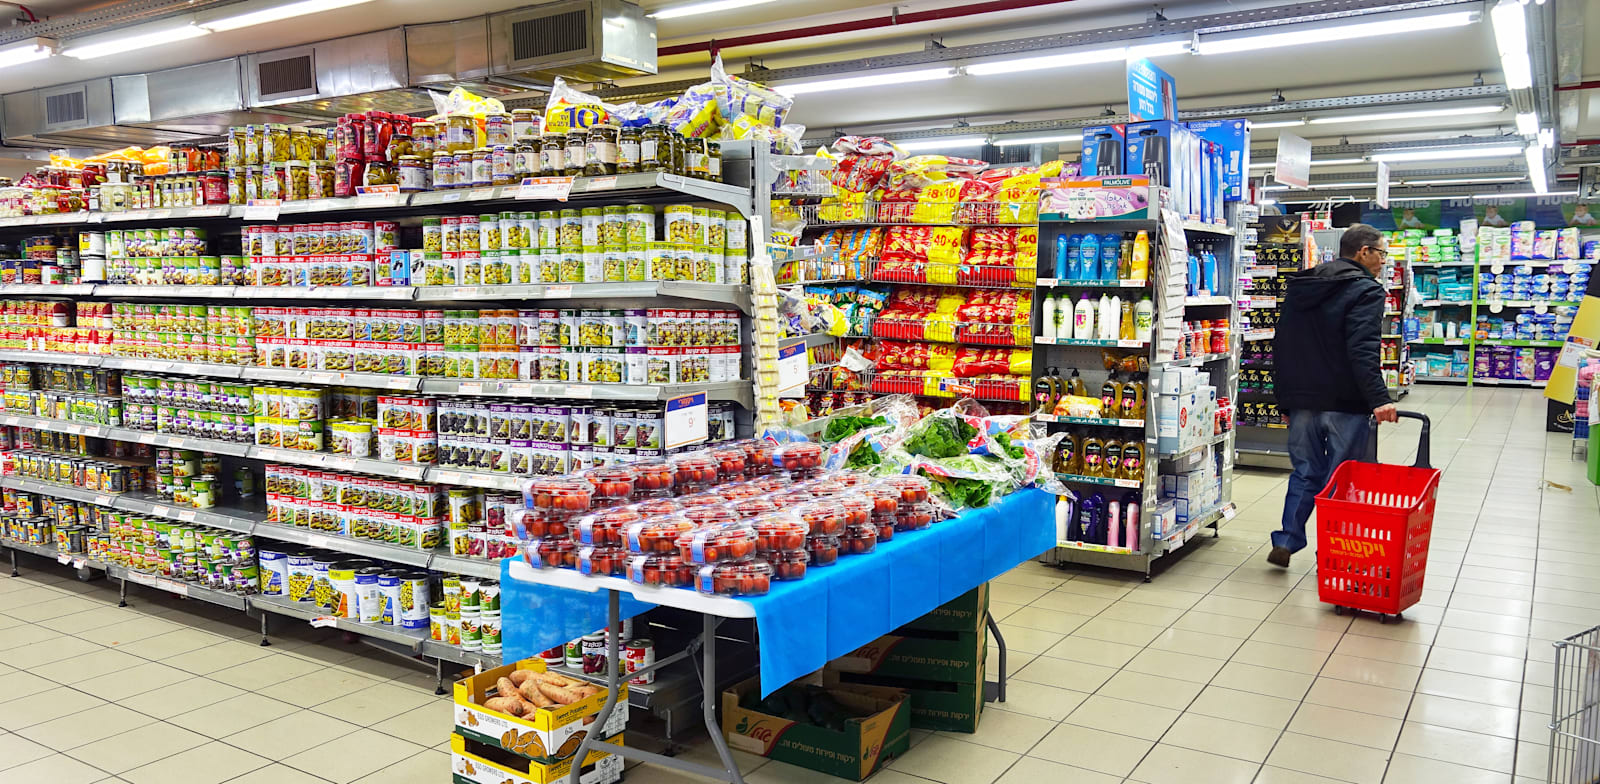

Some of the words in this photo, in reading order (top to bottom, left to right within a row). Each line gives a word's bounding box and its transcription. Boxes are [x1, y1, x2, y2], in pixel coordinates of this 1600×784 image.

[1103, 178, 1131, 186] PALMOLIVE
[1330, 537, 1385, 558] ויקטורי
[950, 659, 969, 668] ירקות
[556, 712, 569, 720] Sweet
[791, 741, 815, 754] מעולים
[816, 747, 836, 760] ופירות
[837, 752, 856, 764] ירקות
